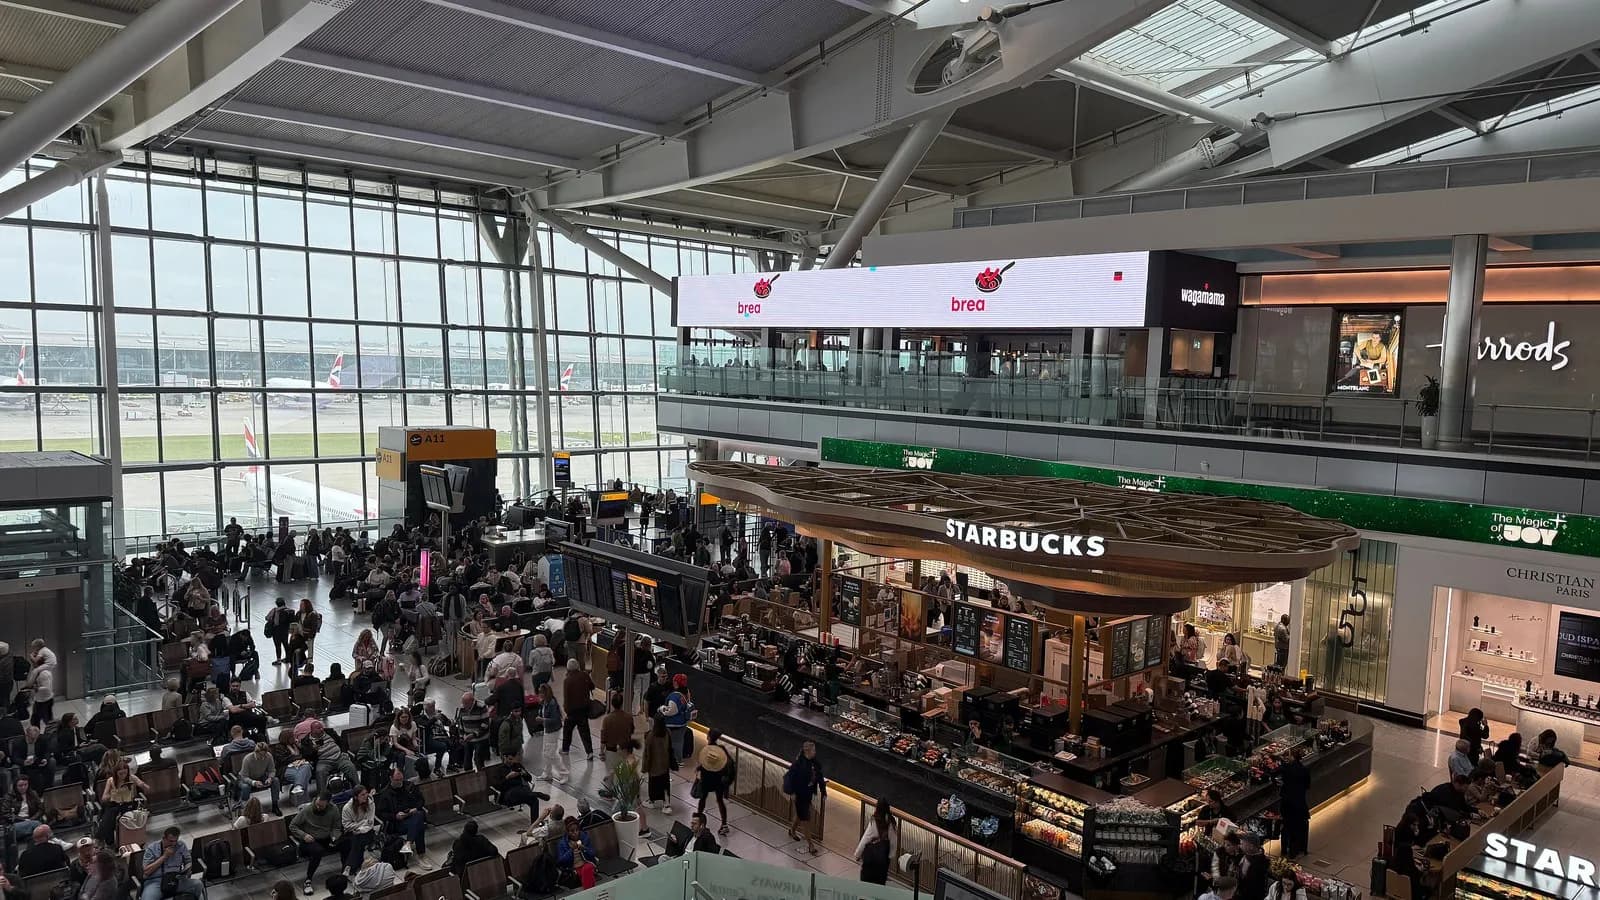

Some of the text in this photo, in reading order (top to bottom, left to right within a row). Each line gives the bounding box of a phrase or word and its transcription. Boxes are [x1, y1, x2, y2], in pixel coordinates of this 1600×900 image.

[951, 296, 985, 312] brea
[1181, 287, 1226, 307] wagamama
[738, 301, 761, 315] brea
[1337, 384, 1370, 392] MONTBLANC
[425, 434, 446, 443] A11
[382, 454, 392, 464] A11
[903, 448, 914, 456] The
[909, 457, 934, 470] JOY
[1117, 475, 1155, 488] The Magic
[1492, 512, 1550, 529] The Magic
[946, 518, 1106, 558] STARBUCKS
[1490, 523, 1559, 546] of JOY
[1506, 567, 1595, 589] CHRISTIAN
[1555, 586, 1591, 599] PARIS
[1486, 834, 1595, 886] STAR
